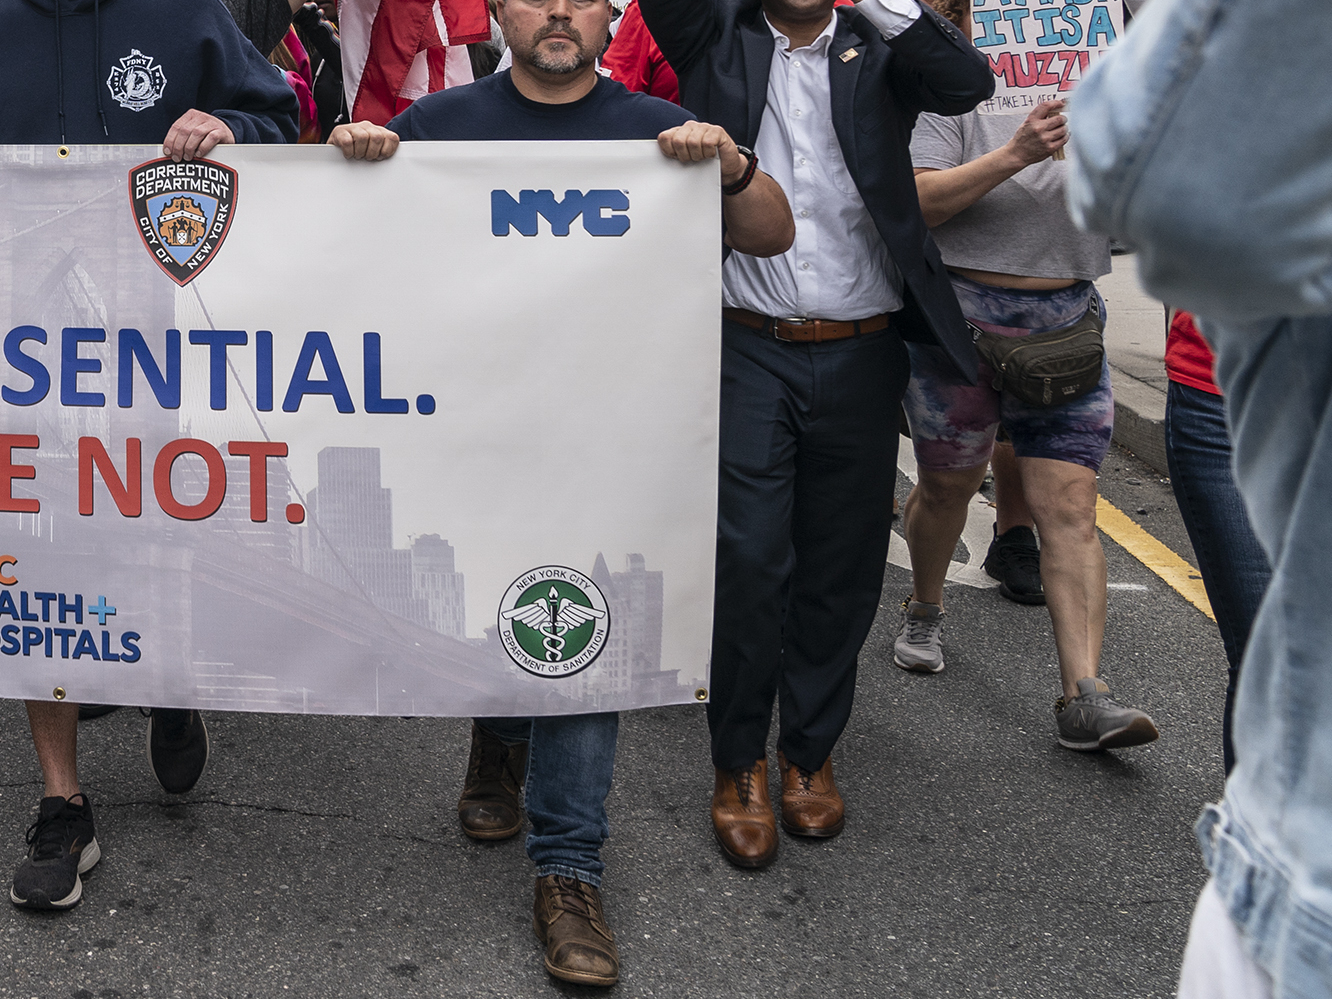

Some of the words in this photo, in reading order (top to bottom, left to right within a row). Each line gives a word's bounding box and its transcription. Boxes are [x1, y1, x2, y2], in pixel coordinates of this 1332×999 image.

[973, 8, 1029, 48] IT
[1033, 4, 1083, 47] IS
[1086, 6, 1118, 47] A
[126, 58, 147, 67] FDNY
[984, 96, 1018, 113] #TAKE
[136, 164, 229, 186] CORRECTION
[136, 177, 229, 200] DEPARTMENT
[491, 189, 631, 237] NYC
[139, 216, 159, 245] CITY
[155, 248, 173, 264] OF
[187, 242, 213, 270] NEW
[209, 203, 229, 240] YORK
[77, 436, 306, 525] NOT.
[516, 573, 537, 592] NEW
[539, 569, 567, 579] YORK
[569, 573, 592, 590] CITY
[503, 629, 546, 672] DEPARTMENT
[548, 665, 560, 673] OF
[562, 628, 605, 672] SANITATION
